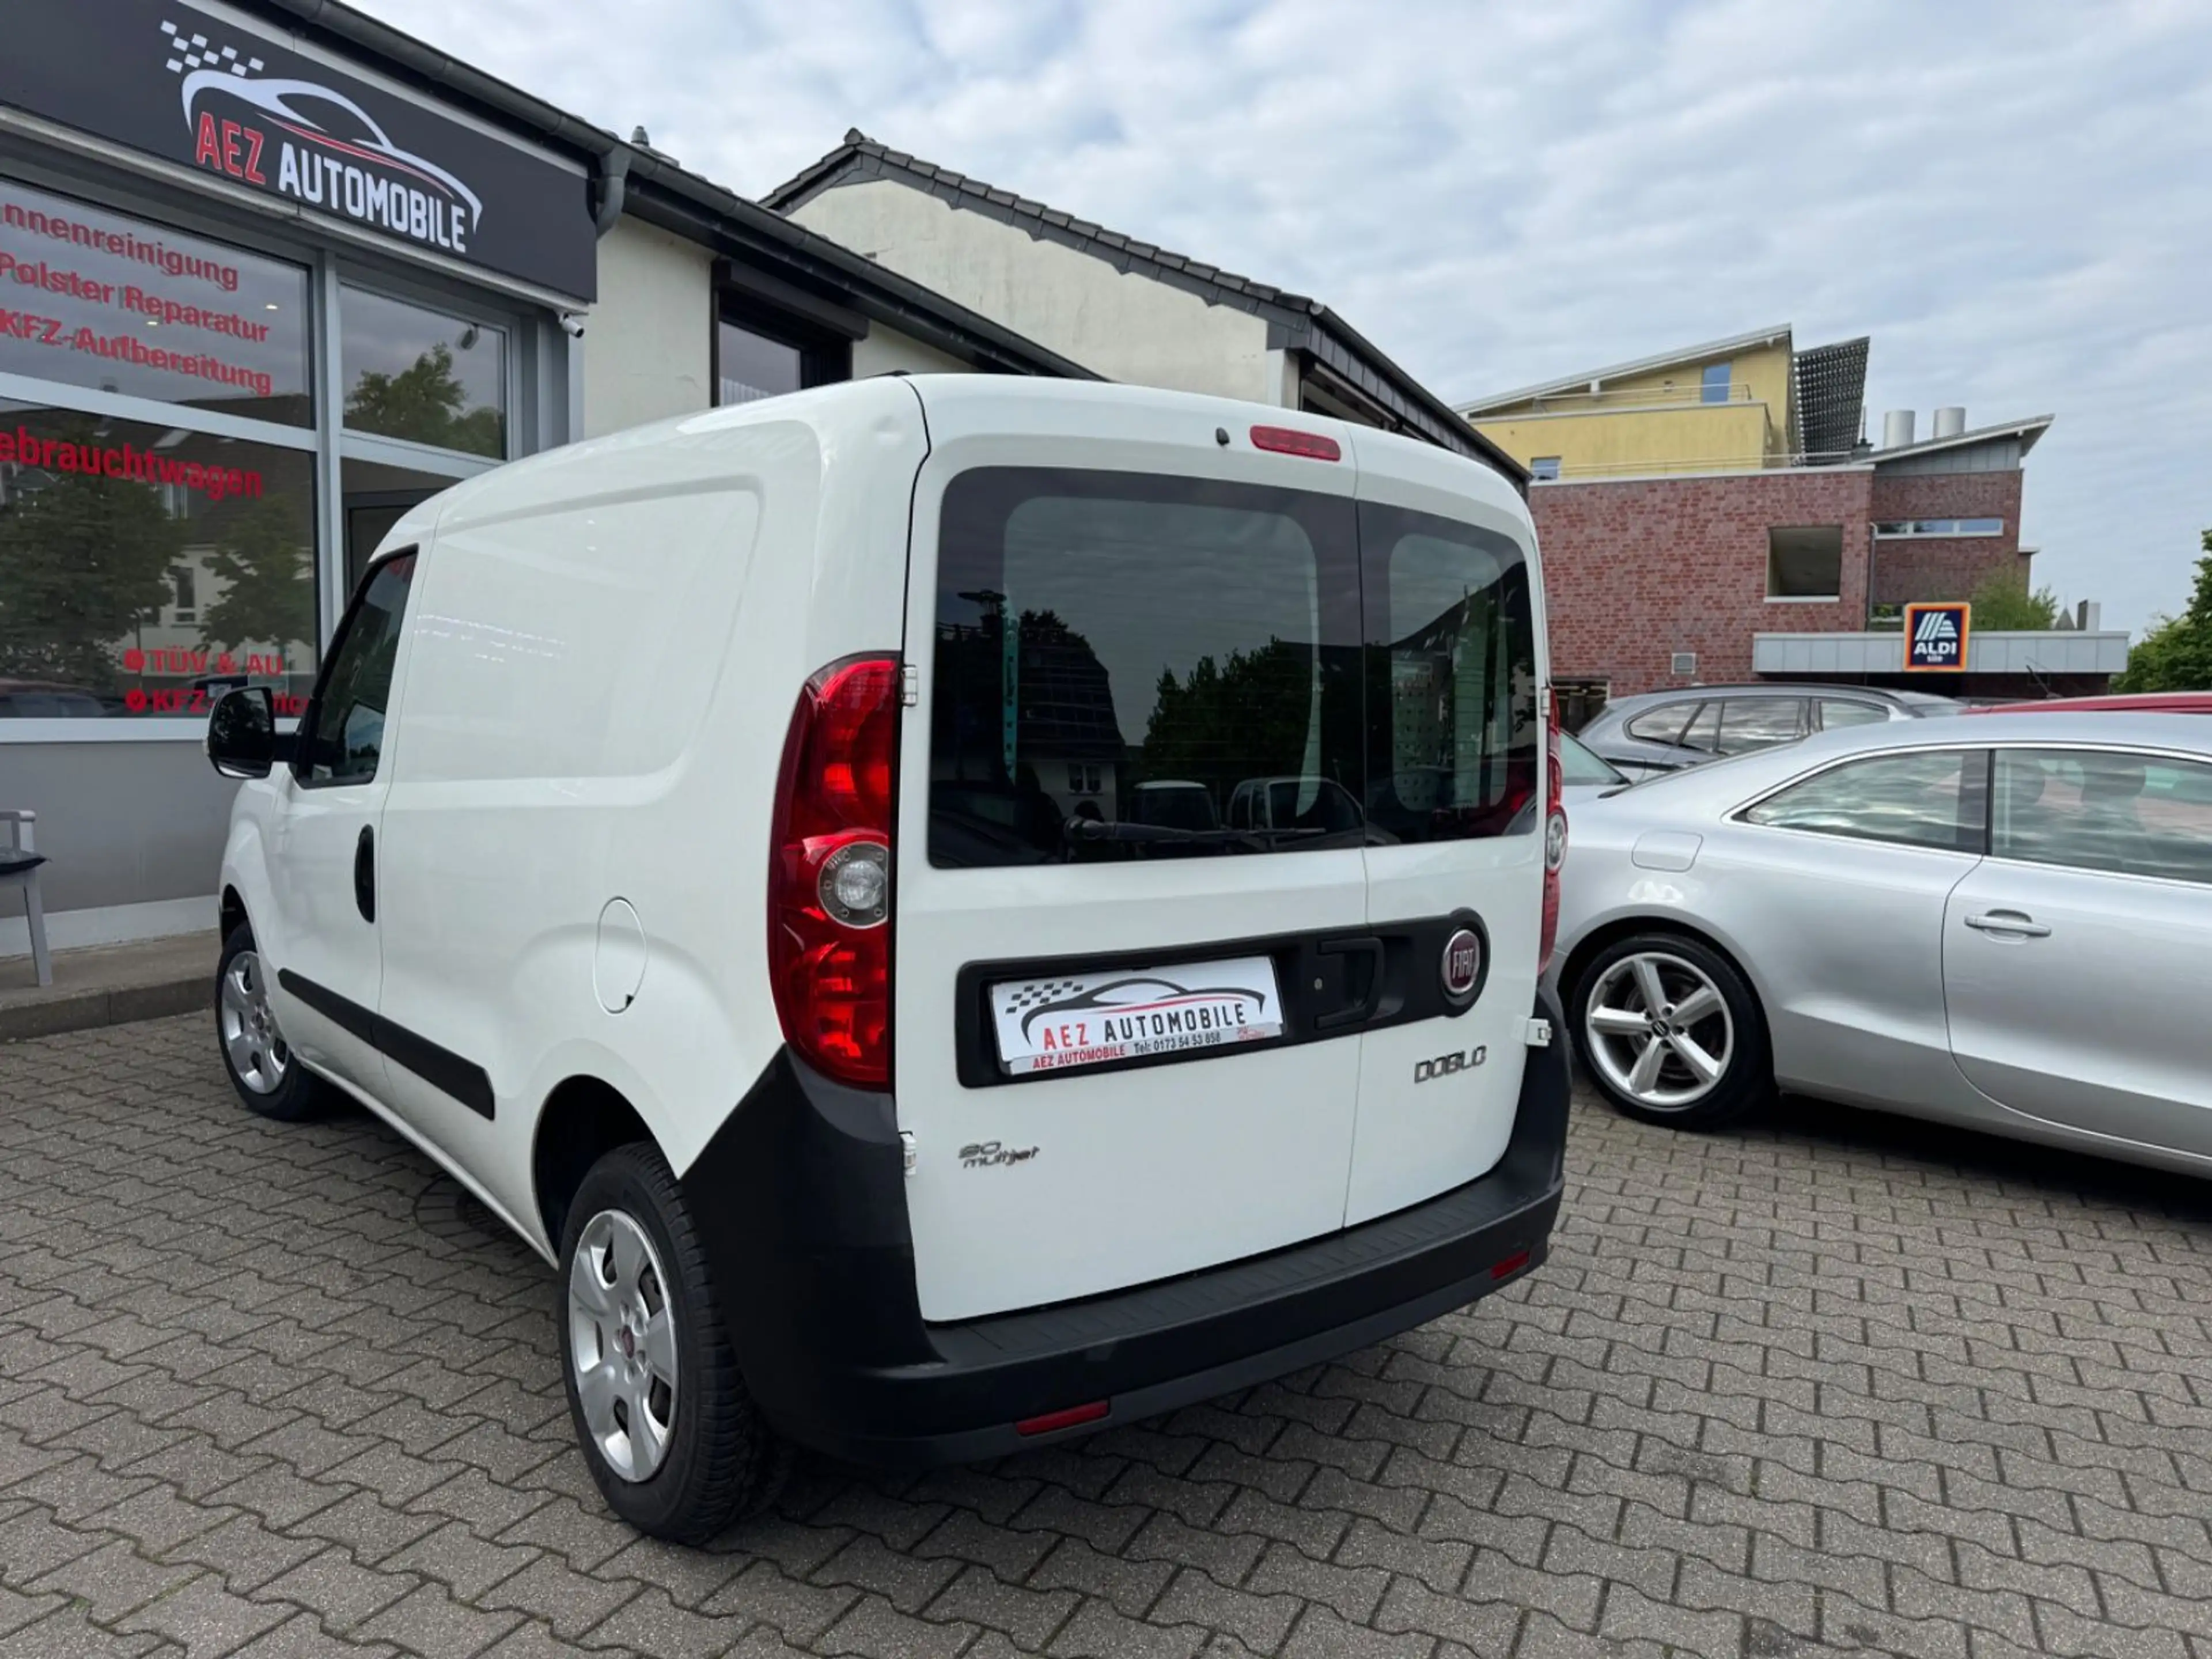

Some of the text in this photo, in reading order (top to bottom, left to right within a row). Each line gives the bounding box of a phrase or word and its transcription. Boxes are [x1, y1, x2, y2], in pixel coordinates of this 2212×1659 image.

[196, 111, 465, 253] AEZ AUTOMOBILE
[2, 203, 238, 291] nnenreinigung
[0, 252, 270, 343] Polster Reparatur
[0, 425, 263, 501] ebrauchtwagen
[149, 645, 208, 673] TÜV
[247, 654, 283, 676] AU
[1914, 641, 1957, 654] ALDI
[1452, 949, 1474, 979] FIAT
[1043, 1022, 1089, 1051] AEZ
[1104, 1003, 1246, 1043] AUTOMOBILE
[1033, 1056, 1054, 1069] AEZ
[1058, 1044, 1126, 1066] AUTOMOBILE
